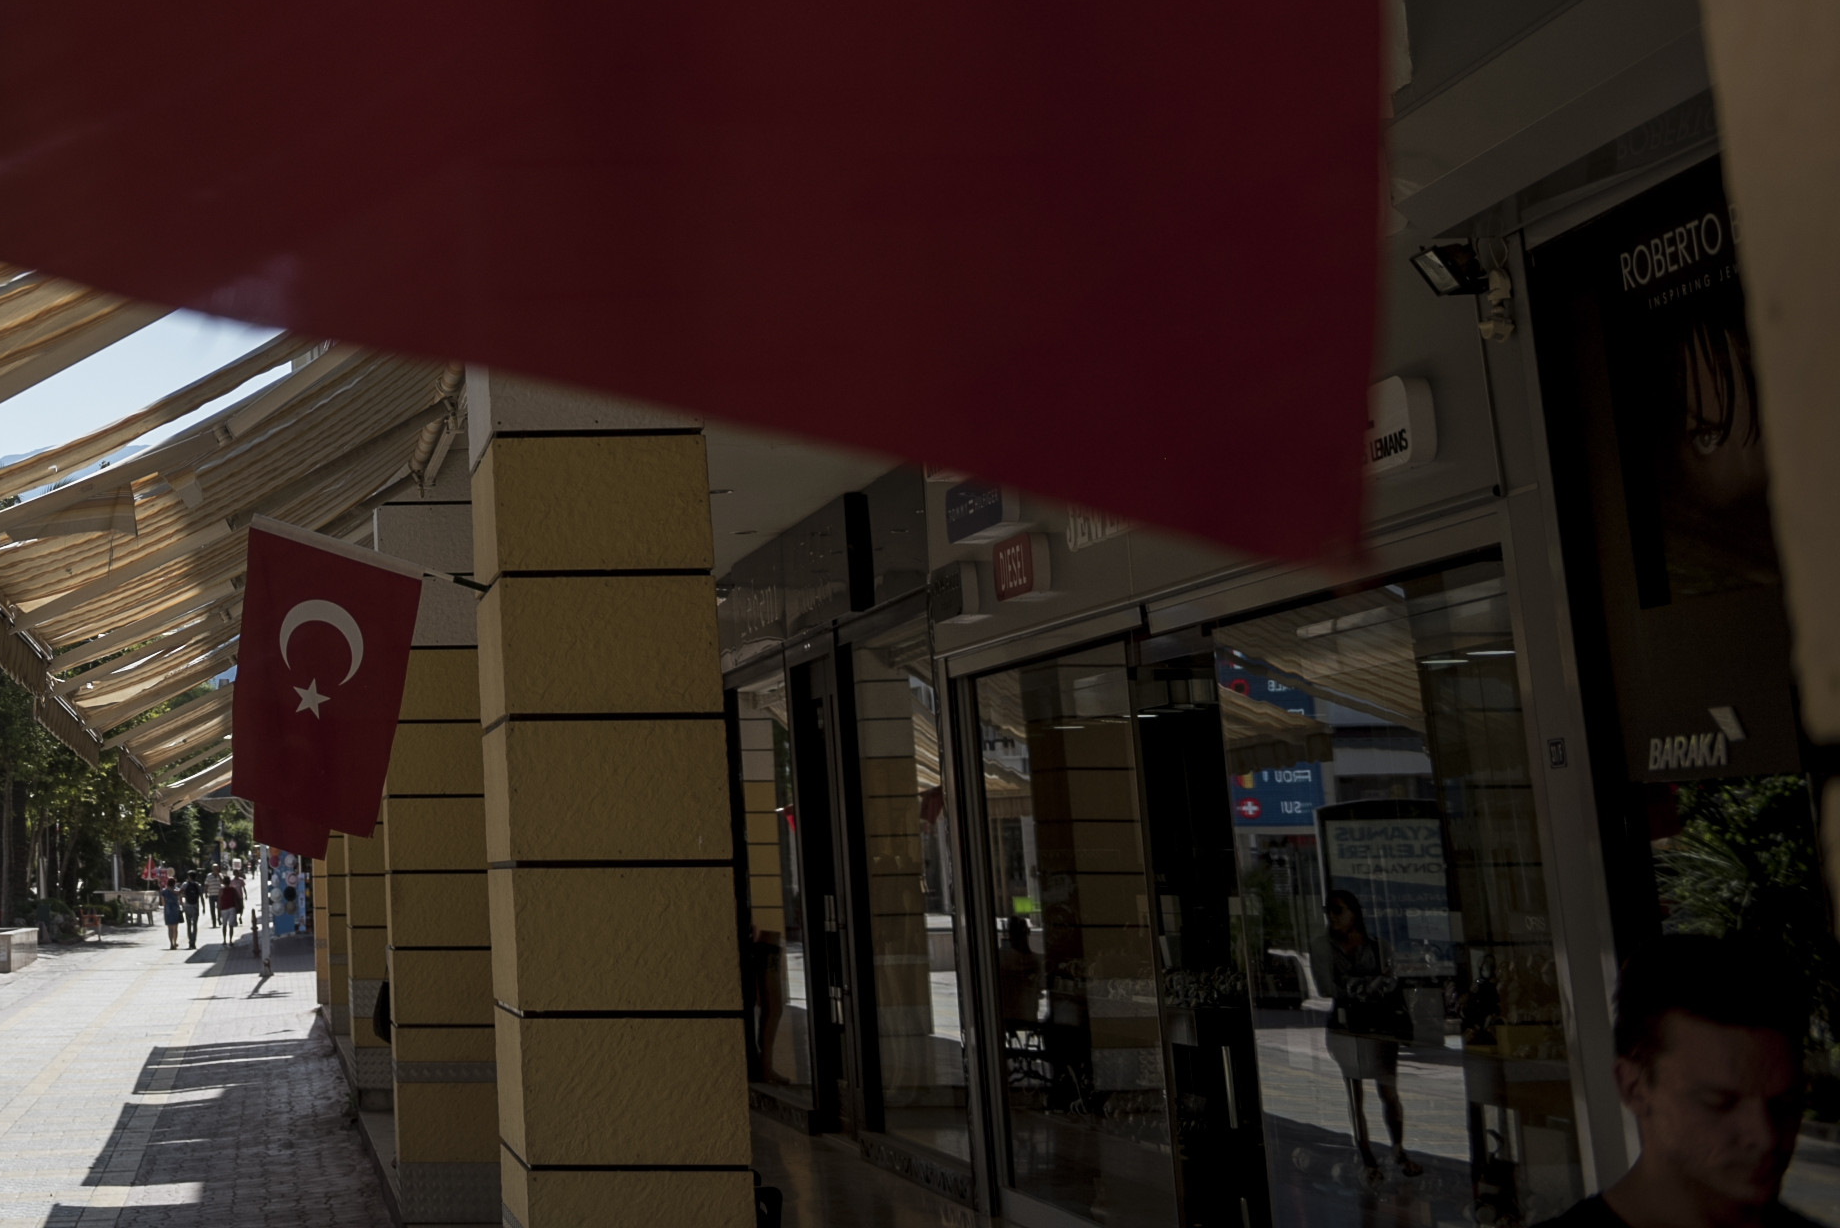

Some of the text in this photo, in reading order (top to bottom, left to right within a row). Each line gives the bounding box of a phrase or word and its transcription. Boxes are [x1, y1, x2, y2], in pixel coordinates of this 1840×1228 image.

[1620, 212, 1722, 292] ROBERTO
[1648, 274, 1711, 310] INSPIRING
[1370, 428, 1409, 462] LEMANS
[999, 543, 1028, 591] DIESEL
[1648, 731, 1728, 771] BARAKA
